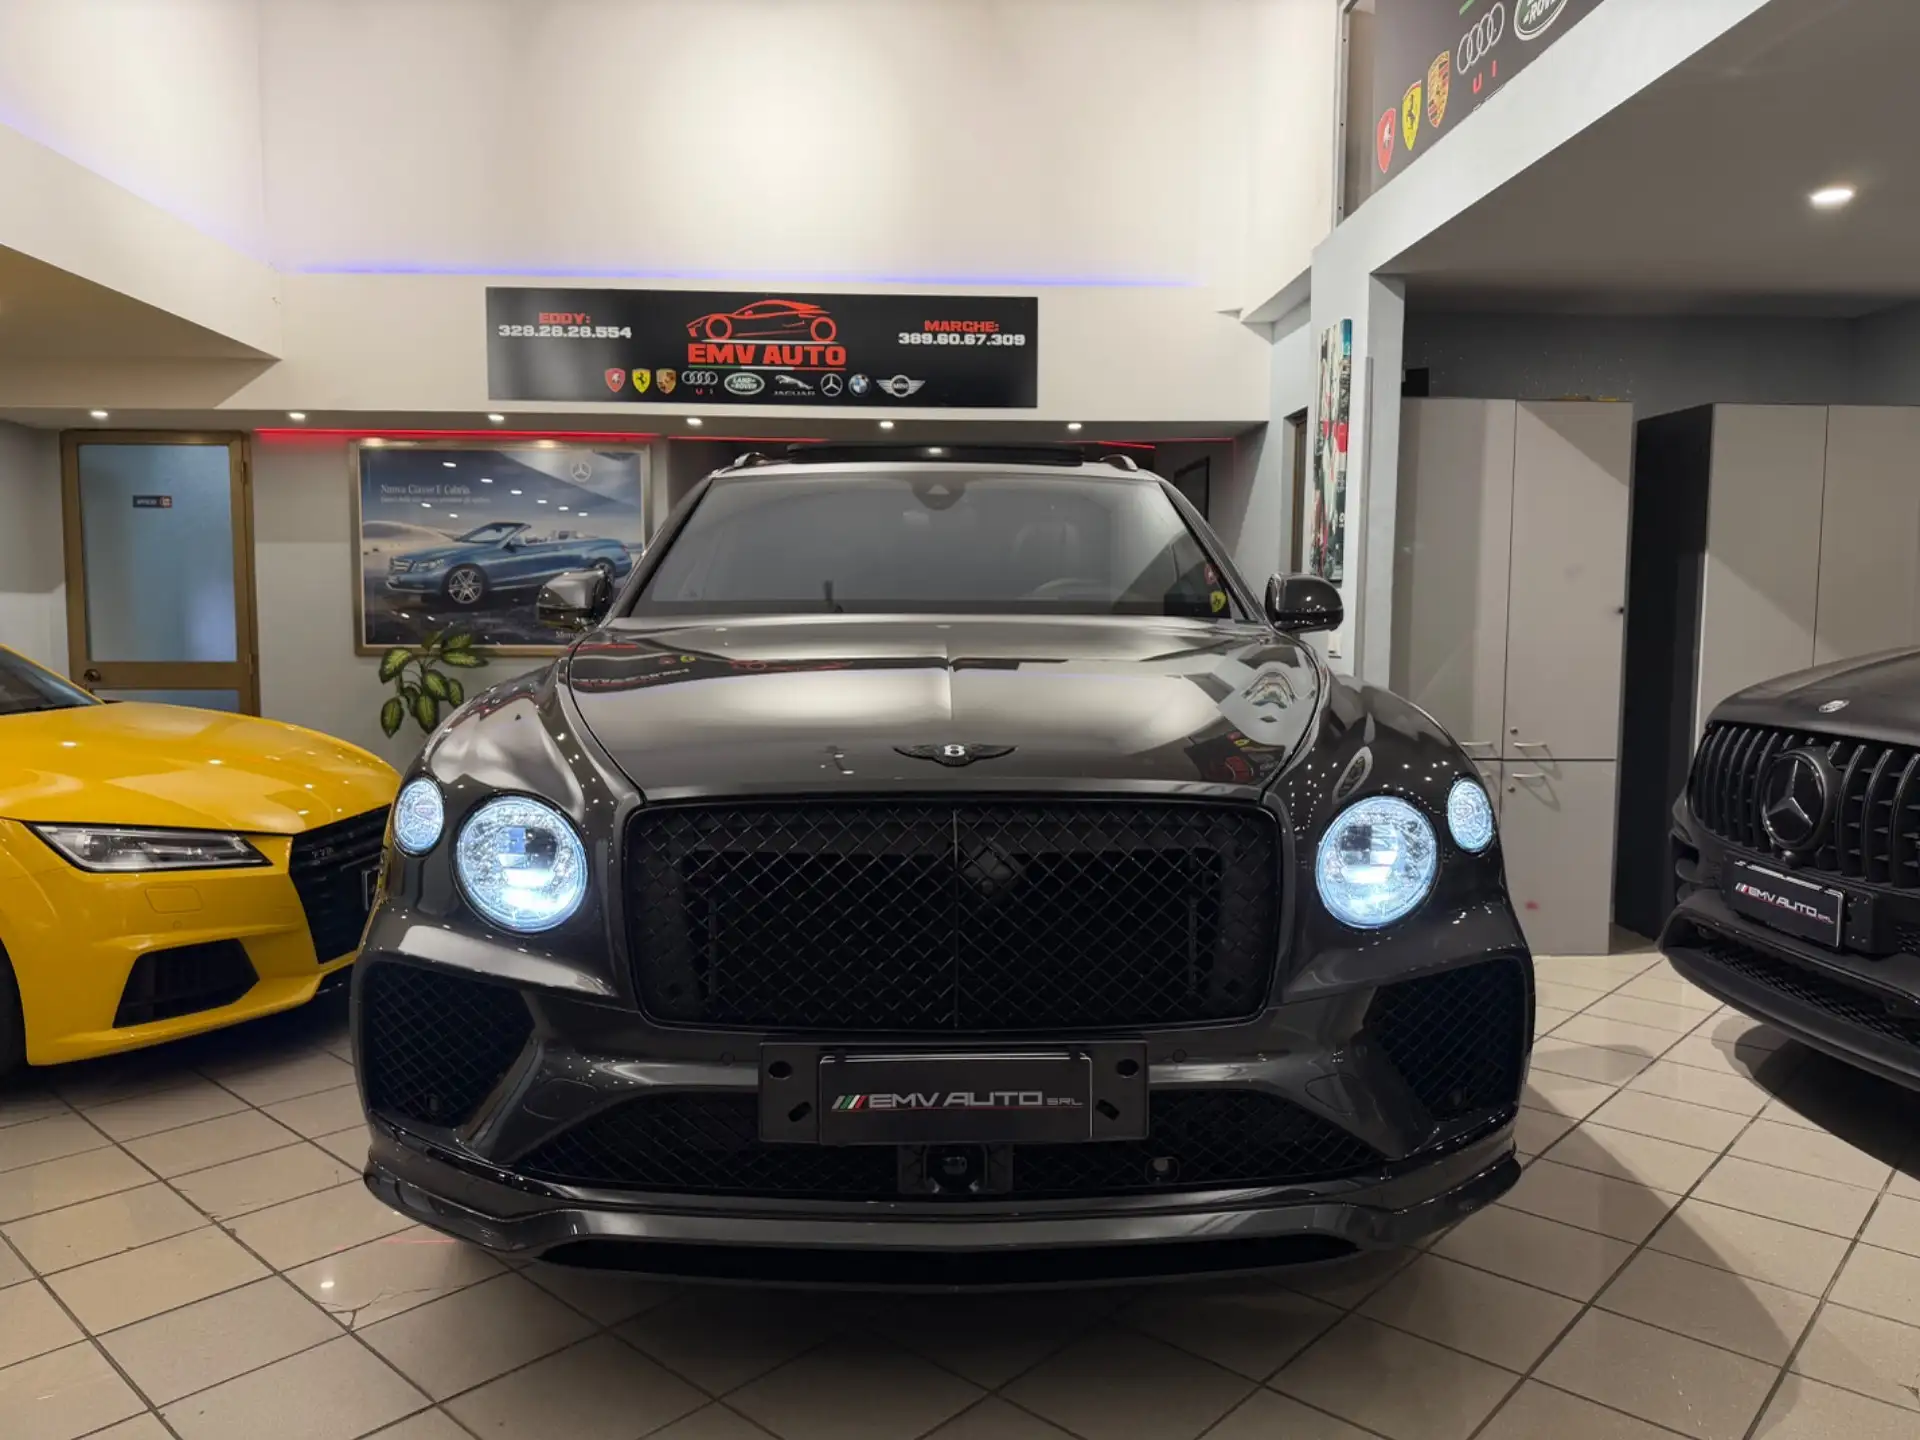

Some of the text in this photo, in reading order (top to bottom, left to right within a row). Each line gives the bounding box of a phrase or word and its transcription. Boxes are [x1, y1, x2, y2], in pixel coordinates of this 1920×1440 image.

[538, 312, 591, 324] EDDY:
[498, 325, 632, 339] 328.28.28.554
[924, 320, 1000, 332] MARCHE:
[687, 343, 847, 366] EMV AUTO
[944, 744, 966, 757] B
[1747, 886, 1776, 903] EMV
[1776, 895, 1818, 918] AUTO
[868, 1091, 1085, 1108] EMV AUTO SRL
